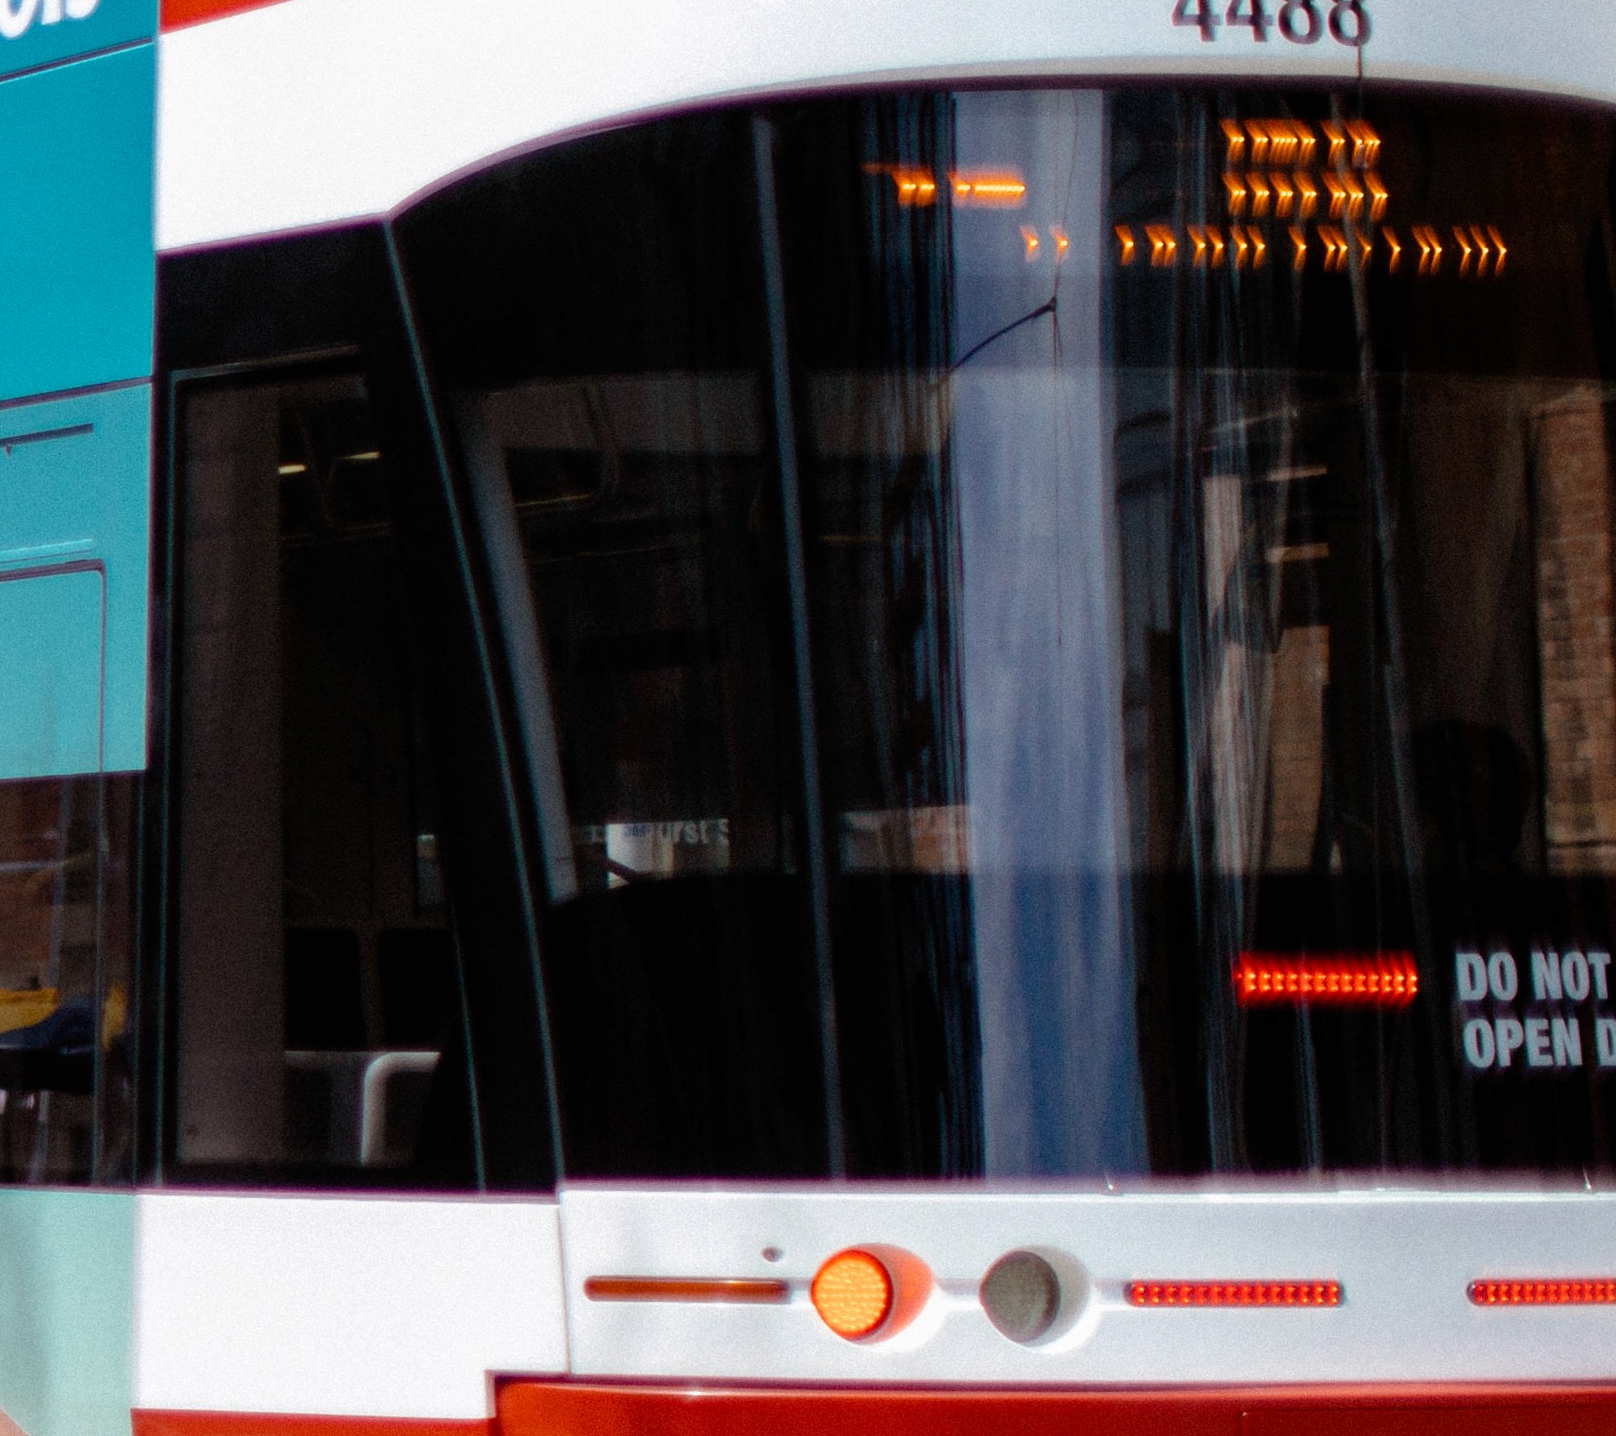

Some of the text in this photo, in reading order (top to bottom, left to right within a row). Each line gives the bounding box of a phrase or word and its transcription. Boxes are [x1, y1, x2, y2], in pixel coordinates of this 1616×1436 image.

[1455, 951, 1612, 1001] DO NOT
[1462, 1017, 1584, 1068] OPEN
